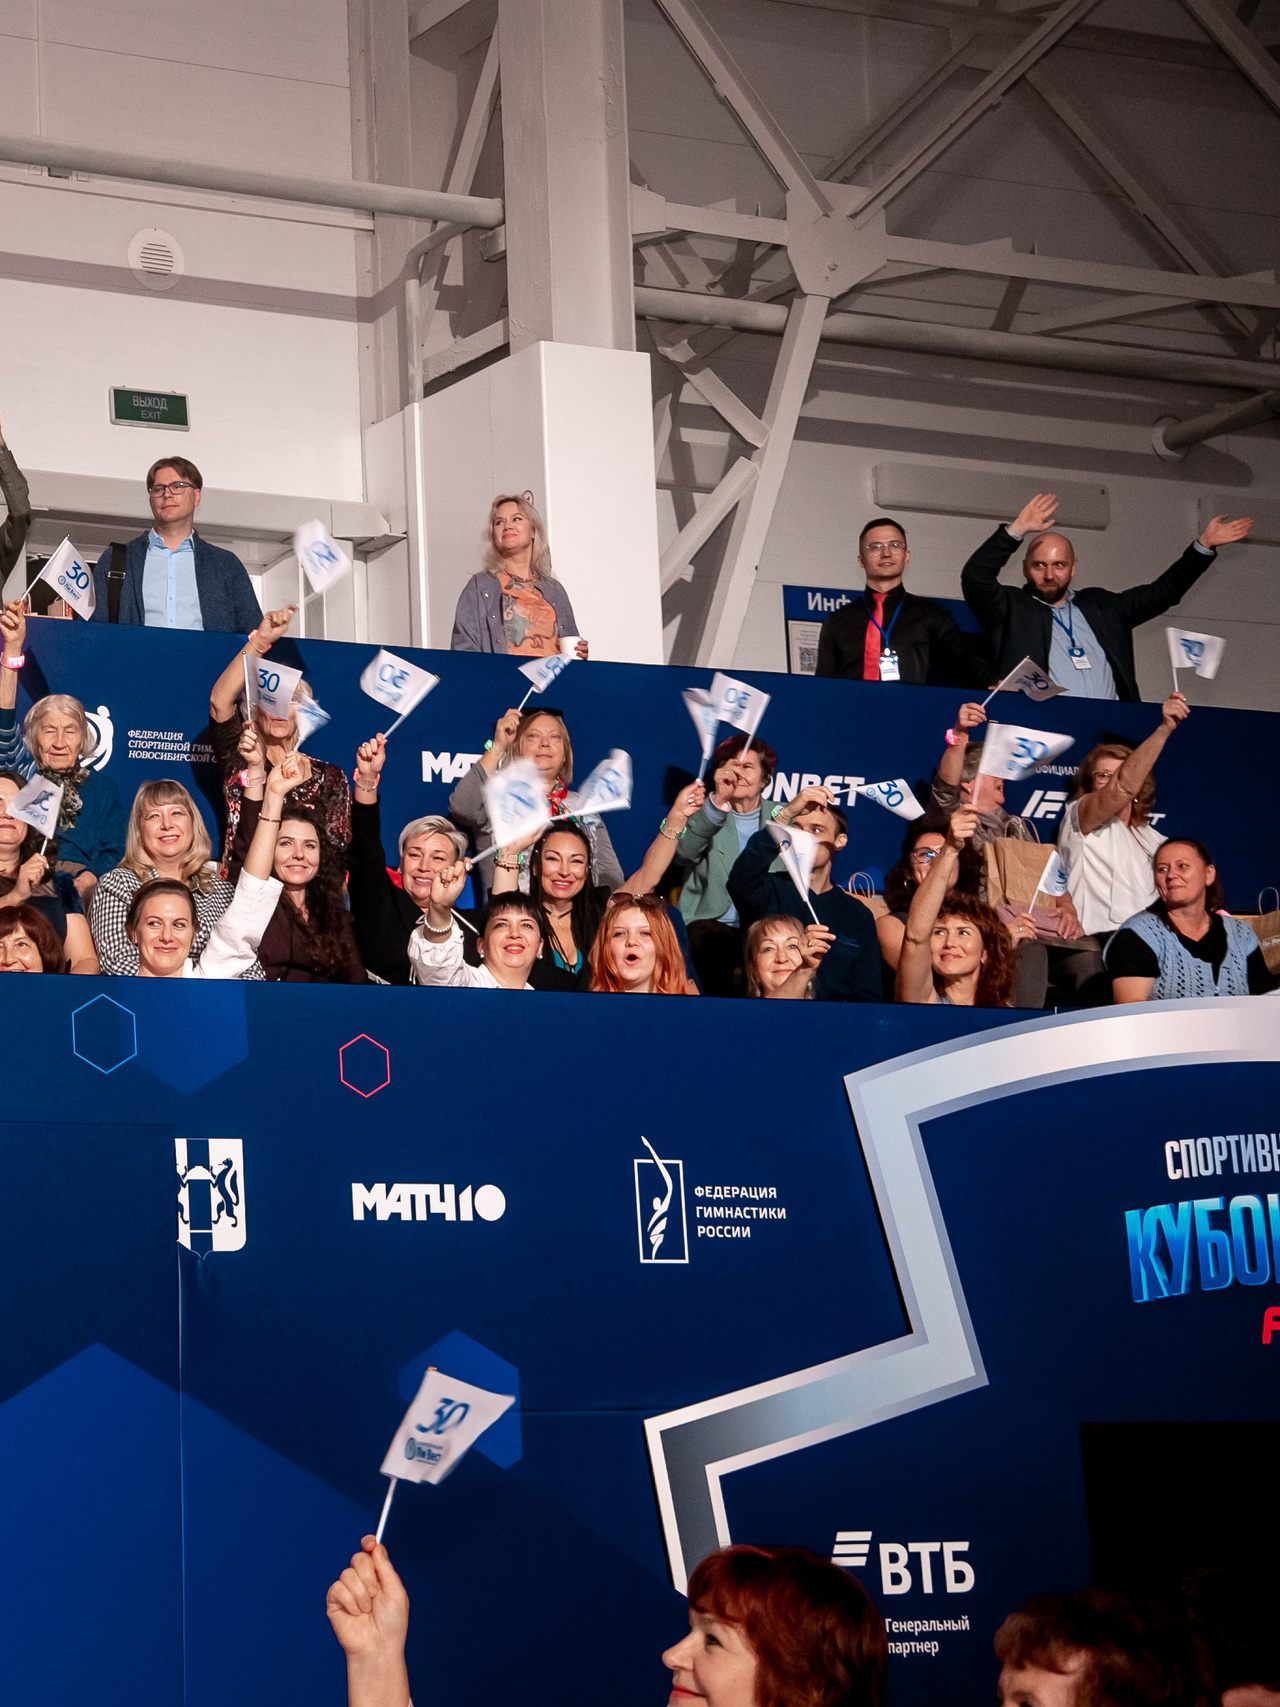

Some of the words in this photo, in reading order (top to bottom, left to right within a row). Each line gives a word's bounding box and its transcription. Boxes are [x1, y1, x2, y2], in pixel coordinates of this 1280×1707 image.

[132, 395, 168, 411] ВЫХОД
[141, 410, 161, 420] EXIT
[66, 560, 89, 590] 30
[807, 591, 851, 612] Инф
[258, 668, 280, 693] 30
[1024, 671, 1049, 691] 30
[127, 729, 183, 741] ФЕДЕРАЦИЯ
[128, 740, 190, 752] СПОРТИВНОЙ
[128, 750, 210, 763] НОВОСИБИРСКОЙ
[878, 780, 904, 808] 30
[694, 1186, 777, 1200] ФЕДЕРАЦИЯ
[696, 1206, 787, 1219] ГИМНАСТИКИ
[697, 1226, 751, 1238] РОССИИ
[415, 1397, 470, 1435] 30
[879, 1541, 975, 1595] ВТБ
[884, 1615, 970, 1636] Генеральный
[888, 1641, 939, 1657] партнер
